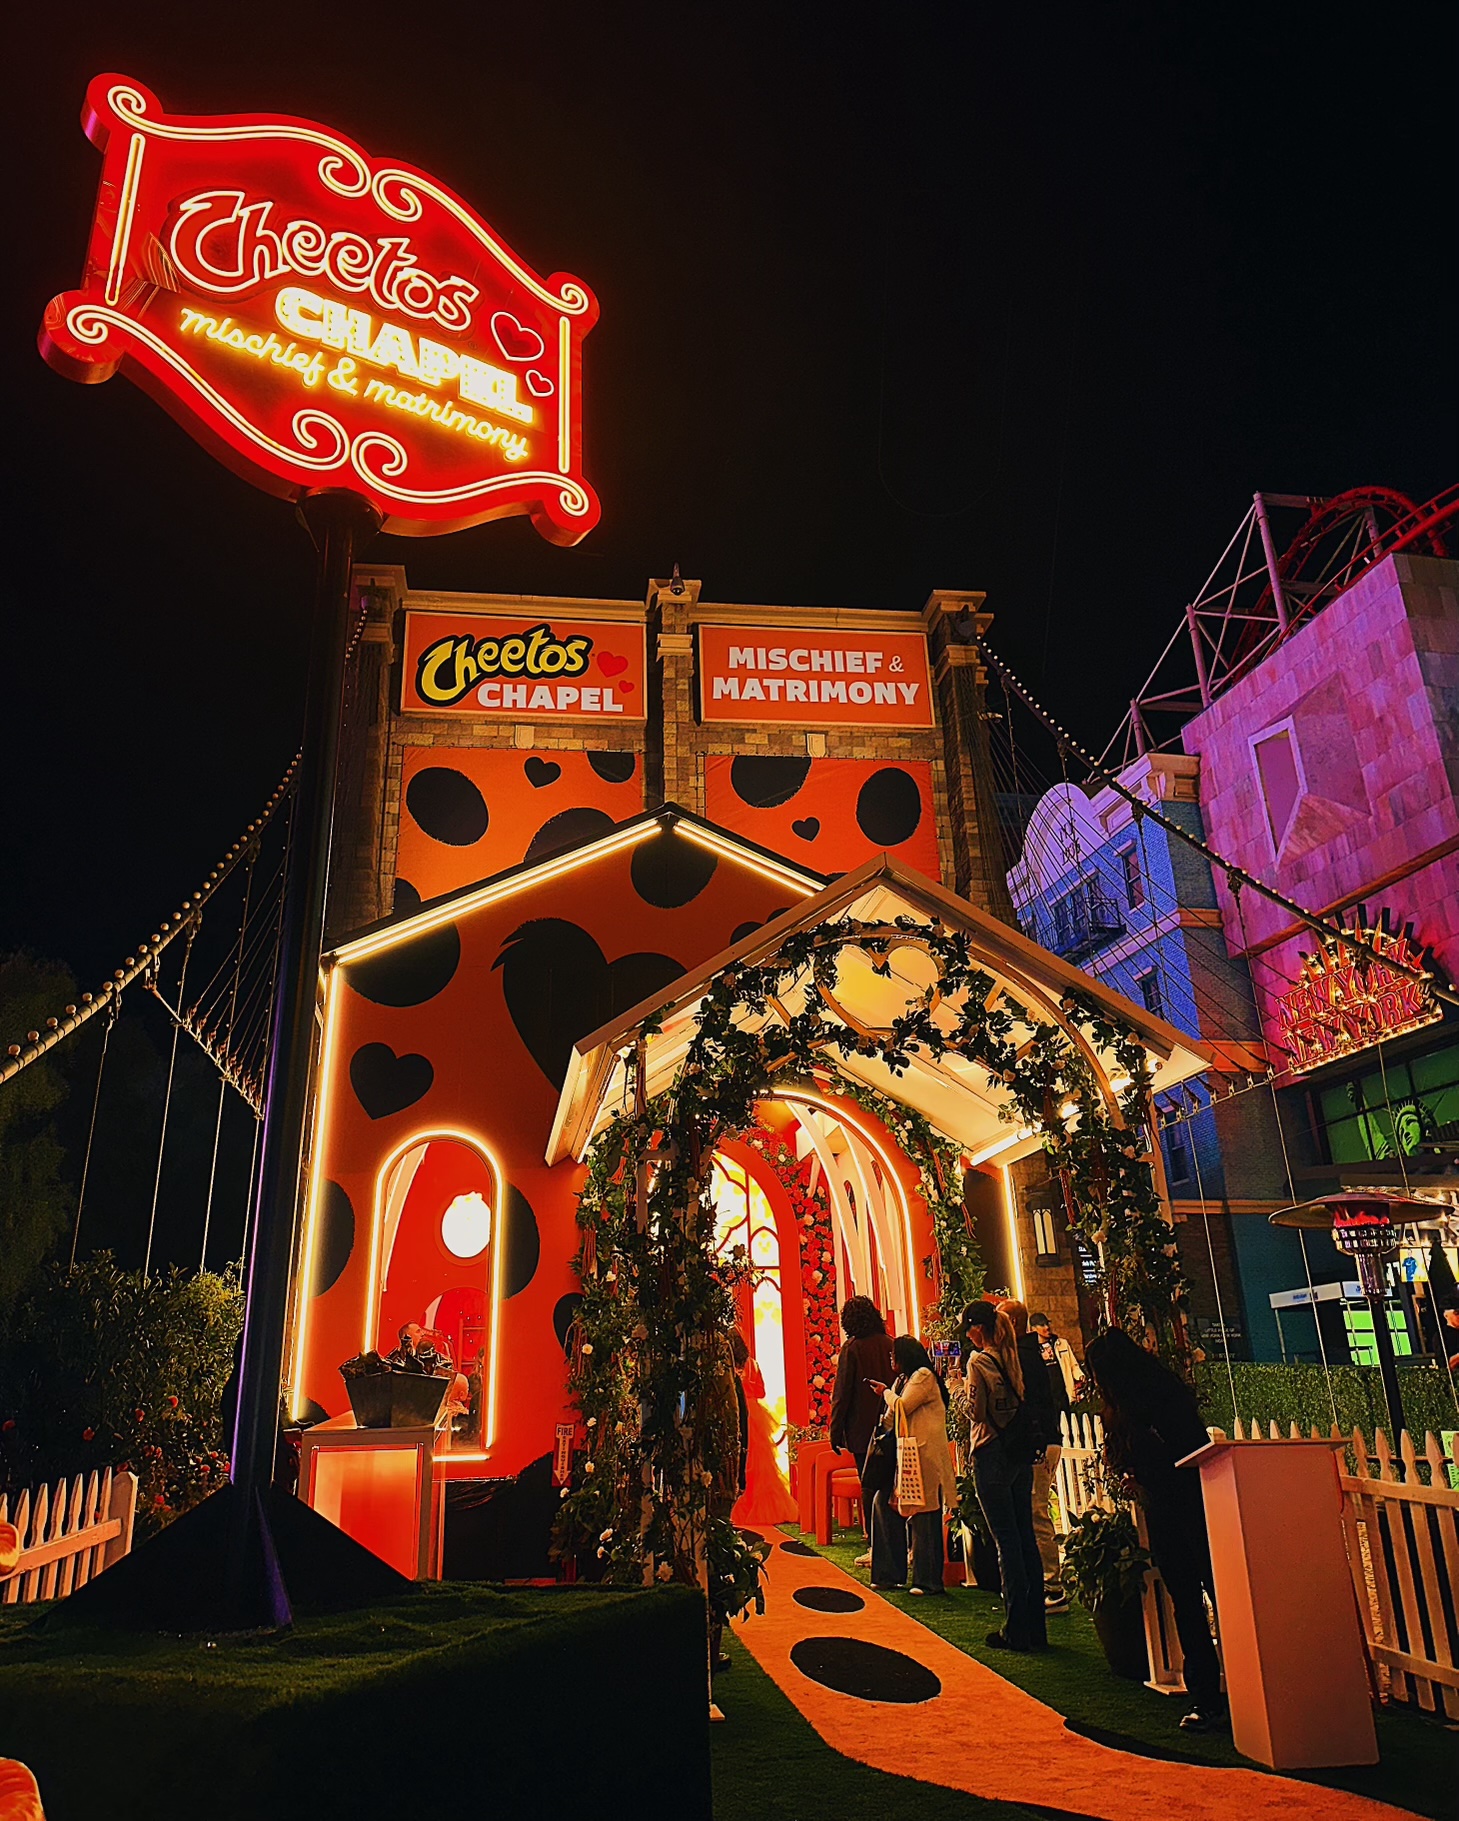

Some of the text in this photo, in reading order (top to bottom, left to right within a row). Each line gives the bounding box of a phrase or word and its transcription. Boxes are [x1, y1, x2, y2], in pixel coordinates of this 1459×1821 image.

[170, 191, 480, 332] Cheetos
[275, 286, 534, 425] CHAPEL
[180, 308, 529, 461] mischief & matrimony
[420, 627, 589, 702] Cheetos
[728, 646, 905, 674] MISCHIEF &
[477, 682, 624, 713] CHAPEL
[712, 676, 920, 706] MATRIMONY
[1276, 974, 1333, 1031] NEW
[557, 1427, 572, 1436] FIRE
